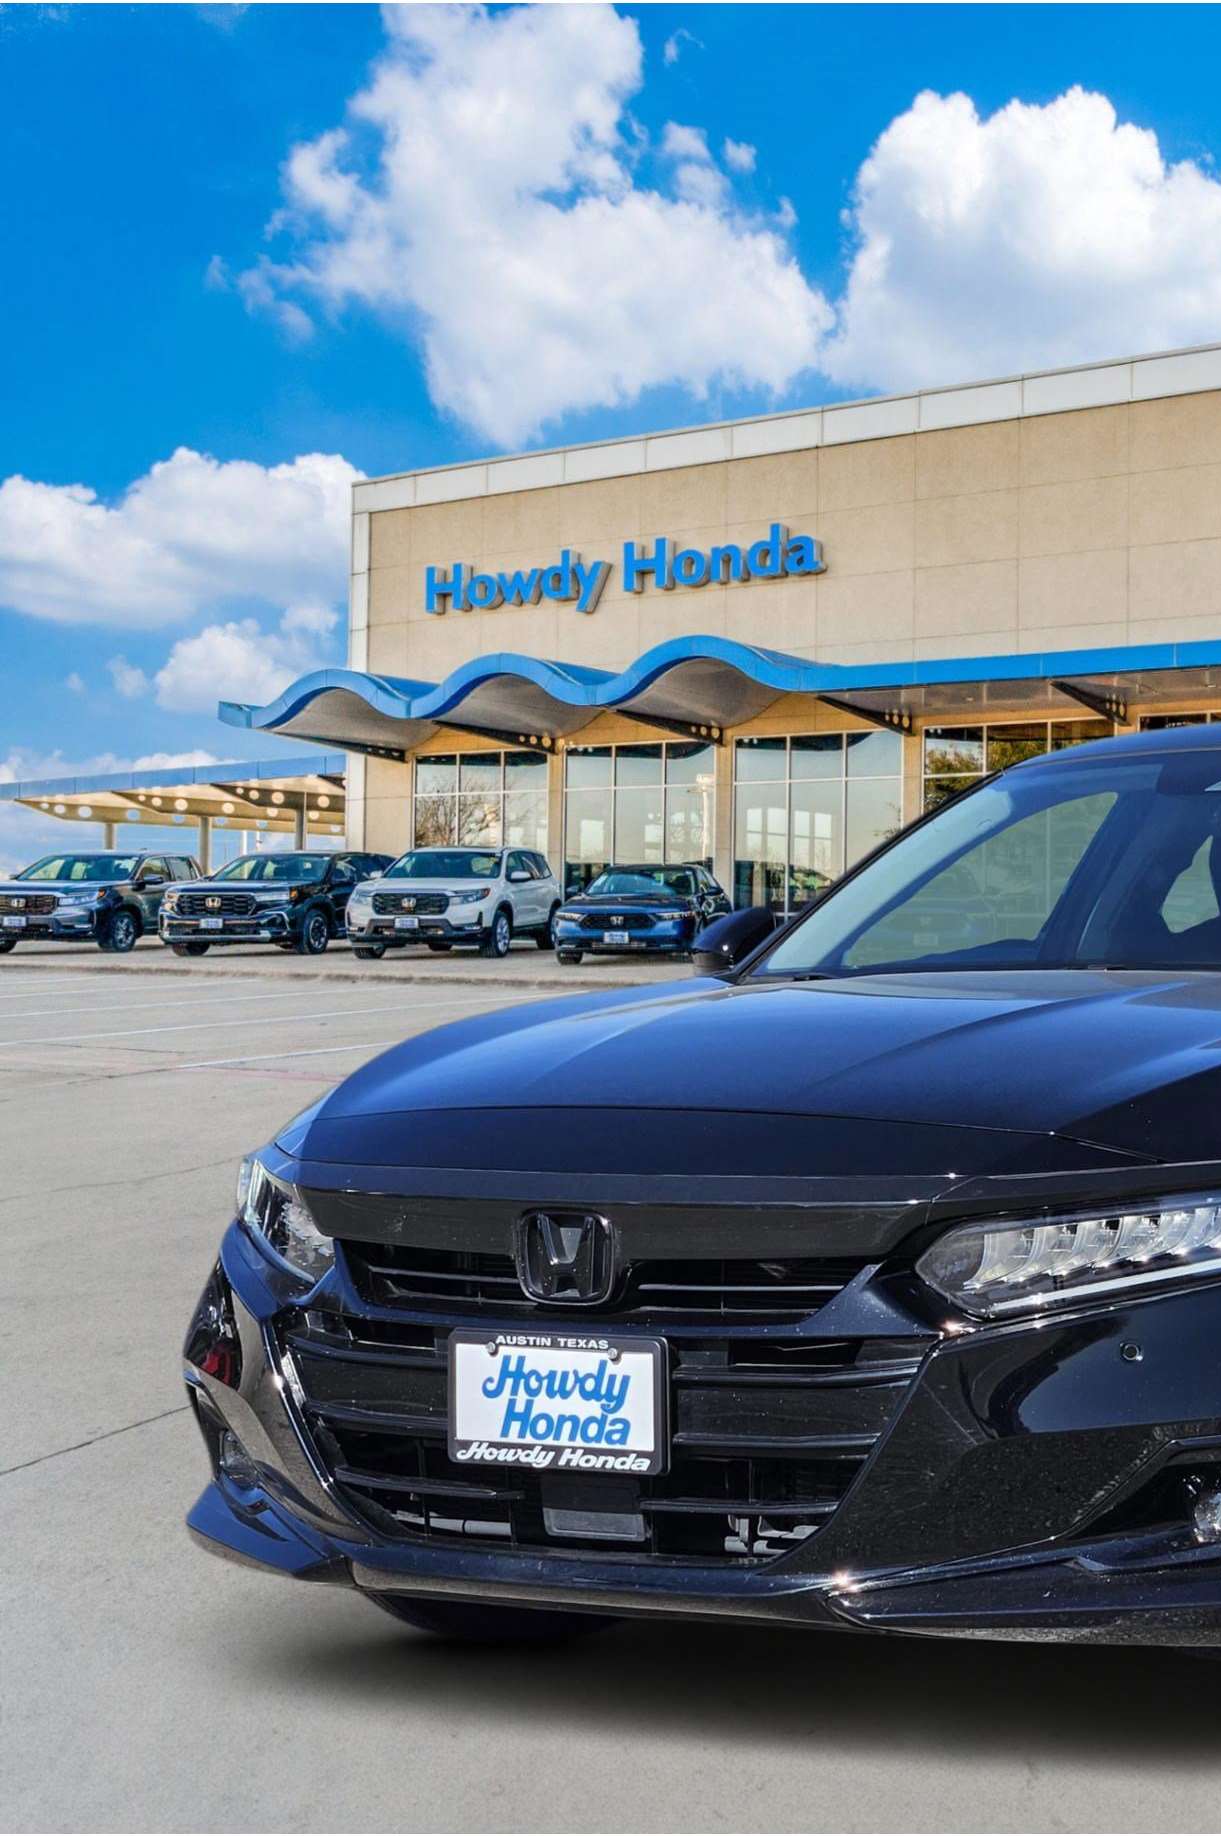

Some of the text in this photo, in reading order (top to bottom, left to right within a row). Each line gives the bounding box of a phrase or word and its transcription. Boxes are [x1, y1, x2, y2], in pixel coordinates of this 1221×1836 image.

[425, 522, 827, 614] Howdy Honda
[495, 1335, 609, 1350] AUSTIN TEXAS
[482, 1355, 631, 1414] Howdy
[500, 1398, 631, 1445] Honda
[456, 1442, 651, 1471] Howdy Honda
